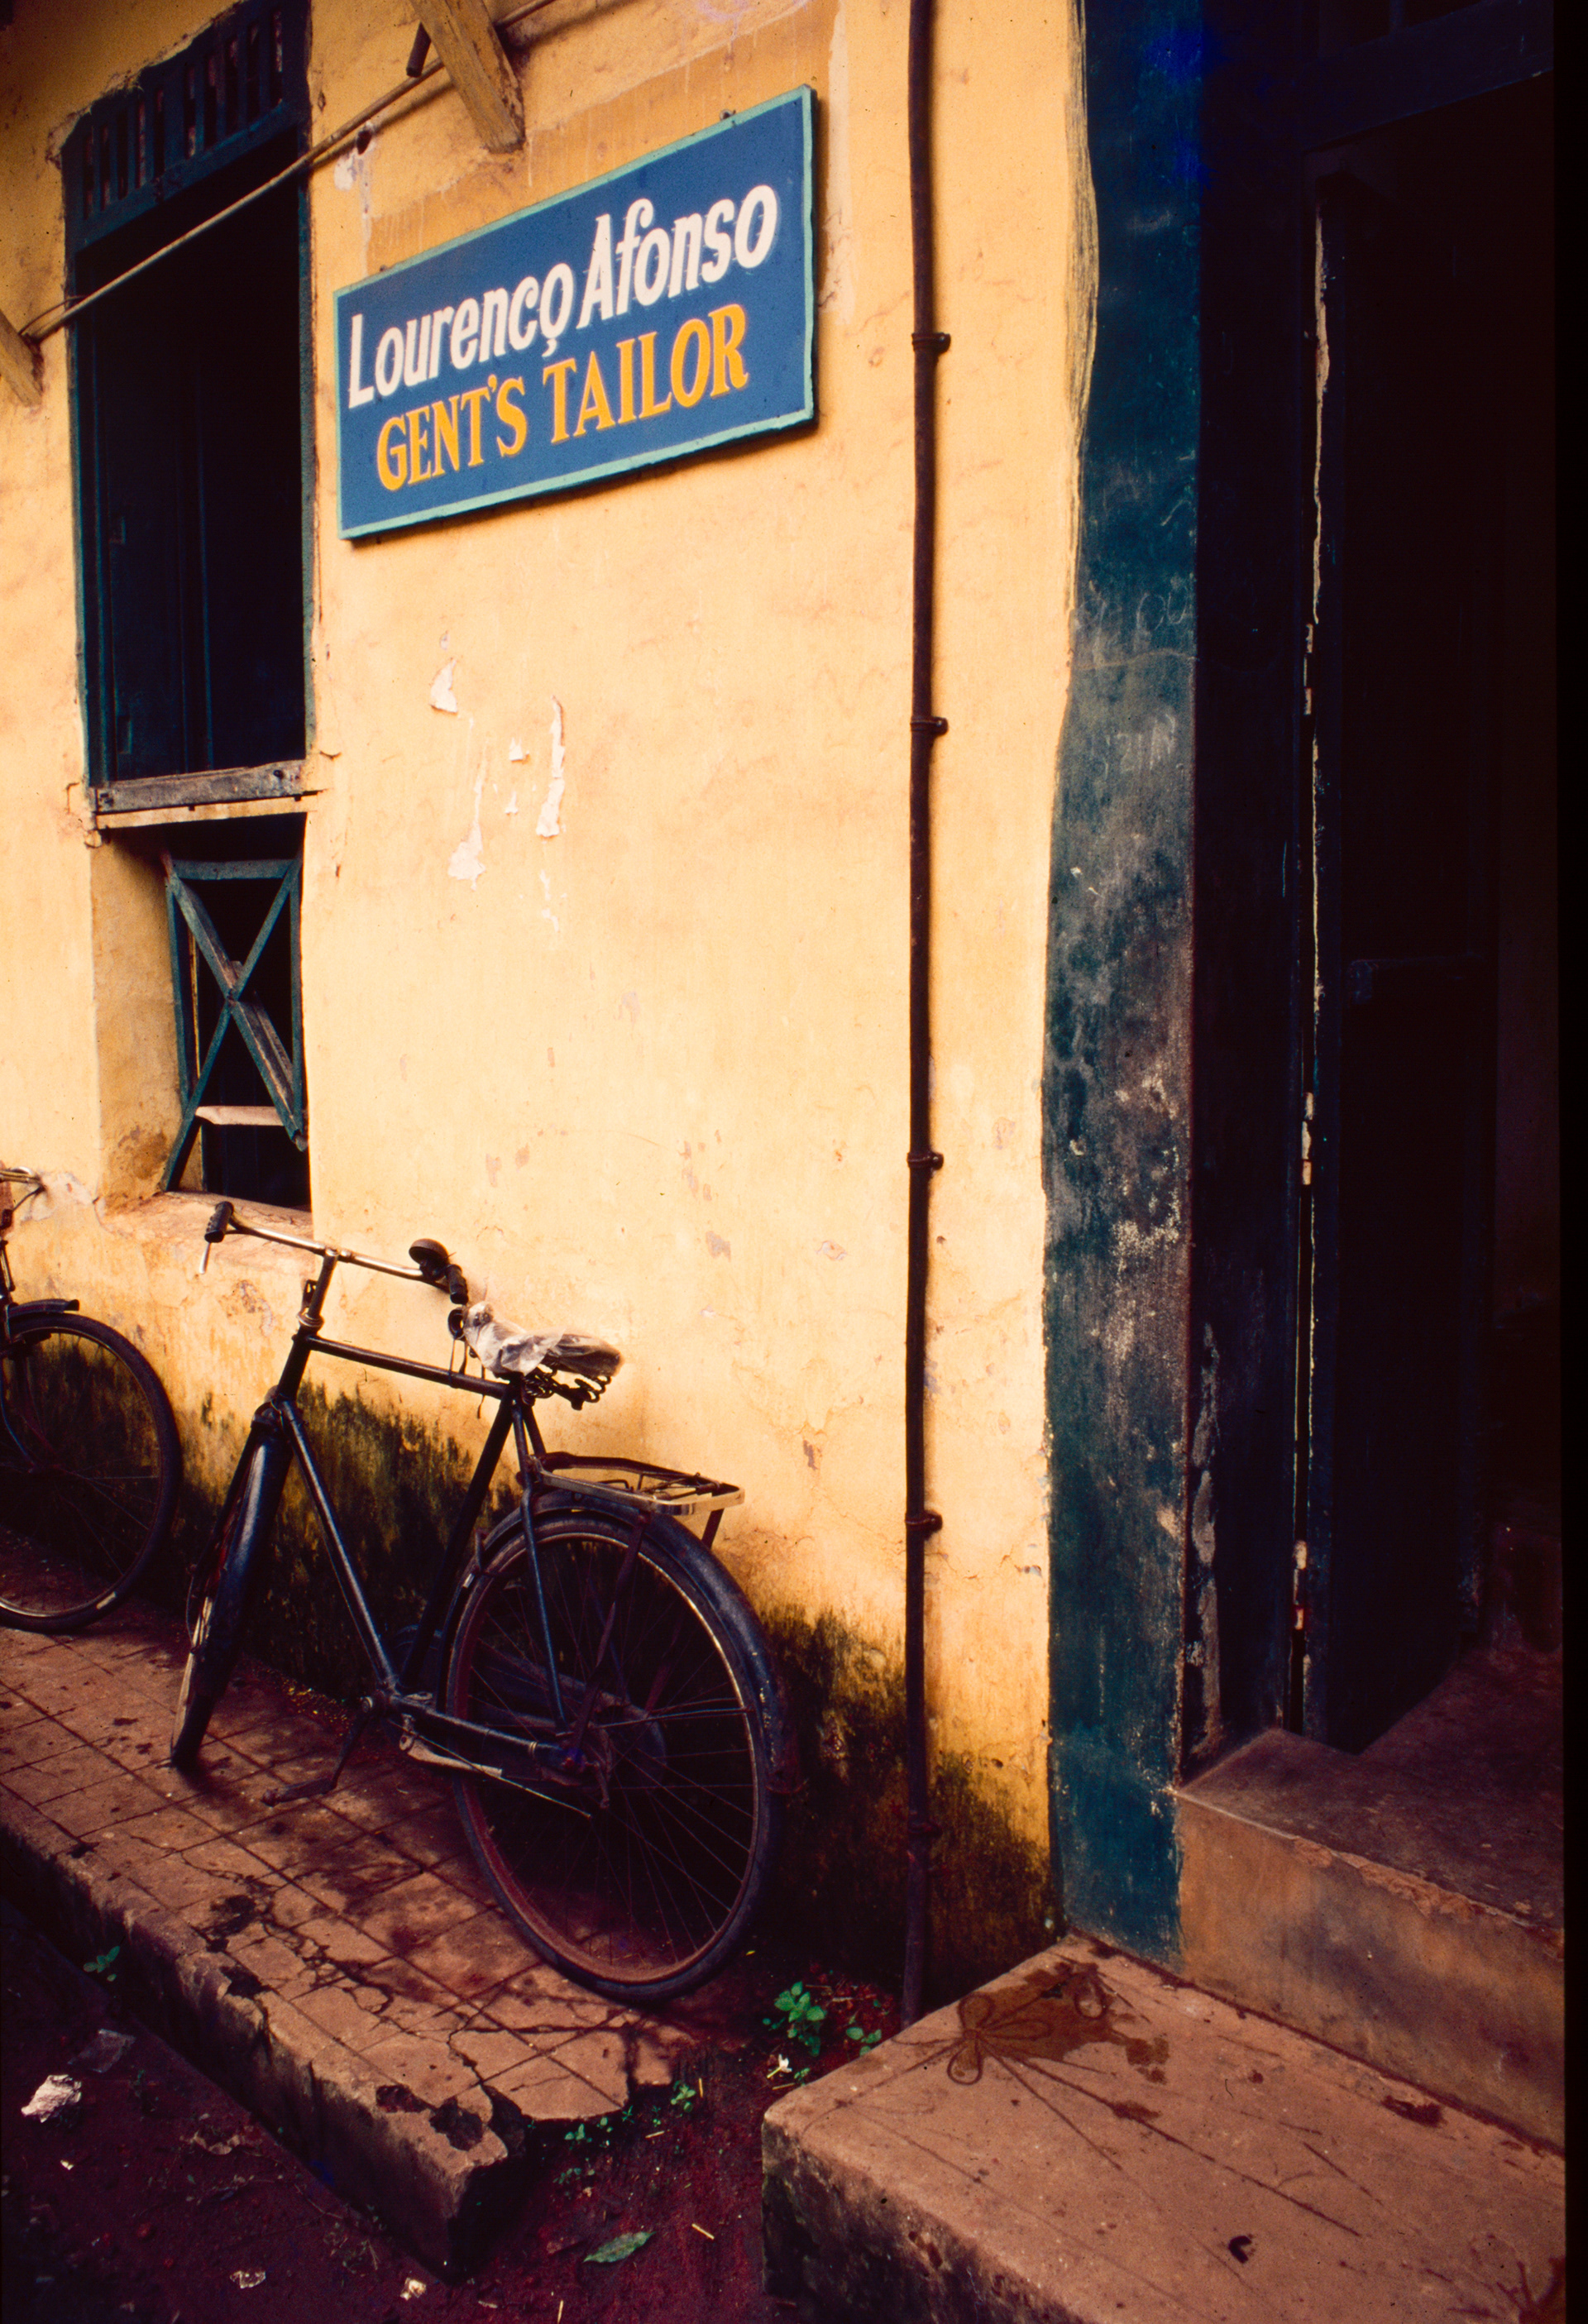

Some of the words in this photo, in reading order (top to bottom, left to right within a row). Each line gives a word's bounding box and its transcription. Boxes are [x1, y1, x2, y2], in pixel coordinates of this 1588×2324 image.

[348, 263, 575, 409] Lourenço
[576, 184, 778, 329] Afonso
[376, 374, 528, 491] GENT'S
[543, 304, 749, 445] TAILOR
